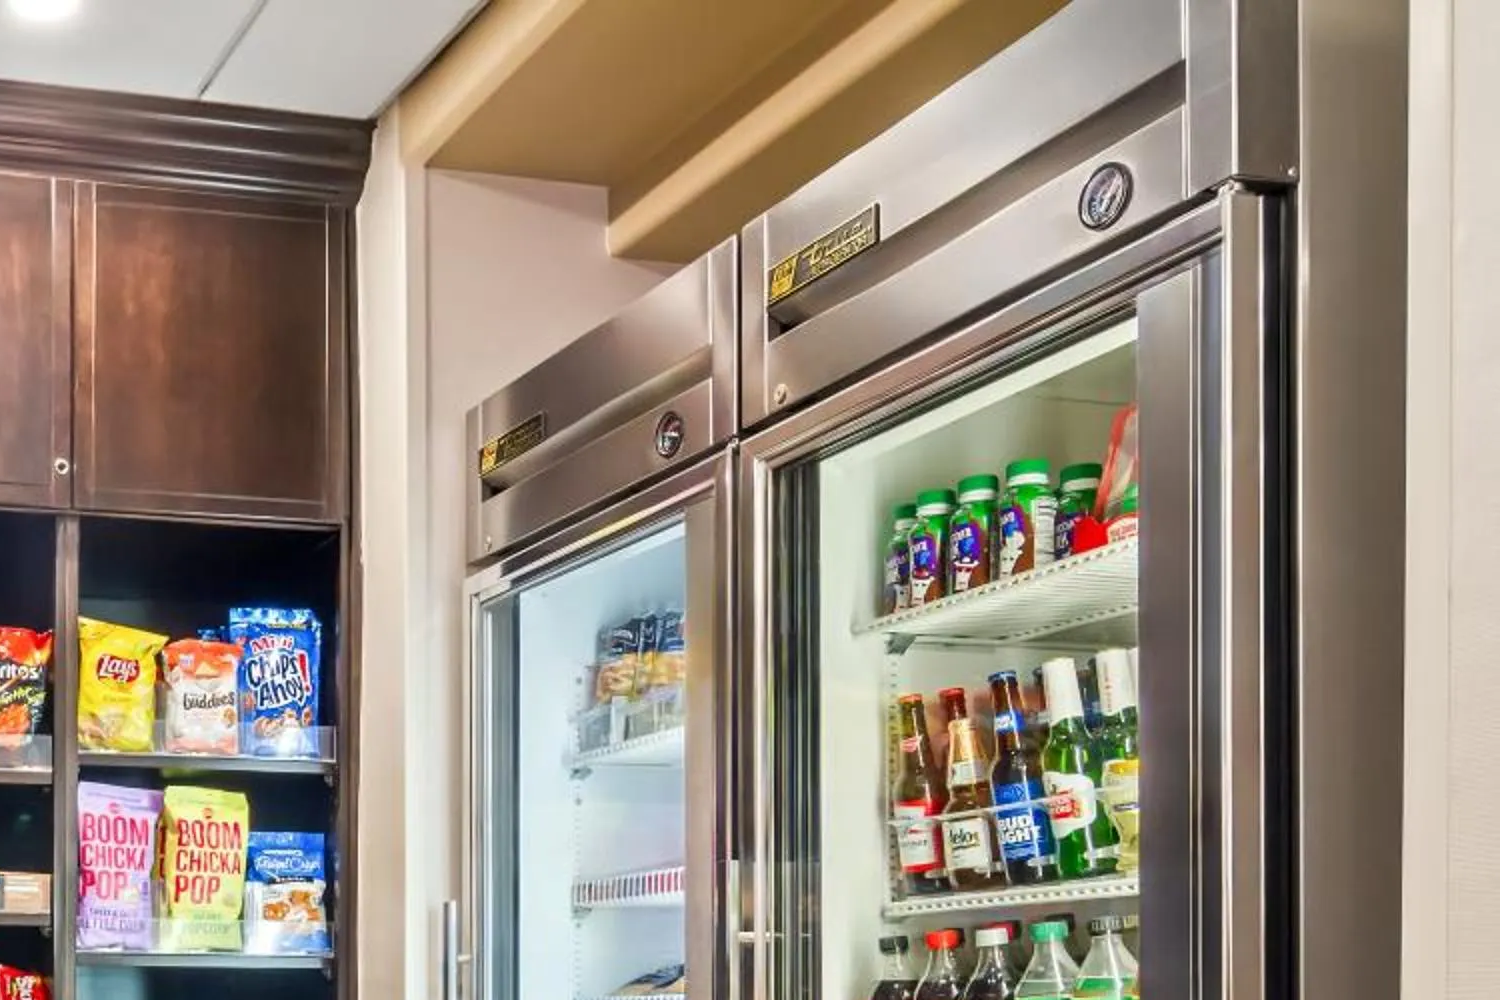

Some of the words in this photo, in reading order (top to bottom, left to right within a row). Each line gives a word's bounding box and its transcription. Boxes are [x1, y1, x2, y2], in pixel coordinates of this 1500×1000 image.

[81, 812, 149, 846] BOOM
[176, 819, 242, 849] BOOM
[1001, 825, 1041, 843] IGHT
[80, 844, 147, 872] CHICKA
[175, 850, 241, 875] CHICKA
[79, 870, 128, 900] POP
[174, 874, 221, 905] POP
